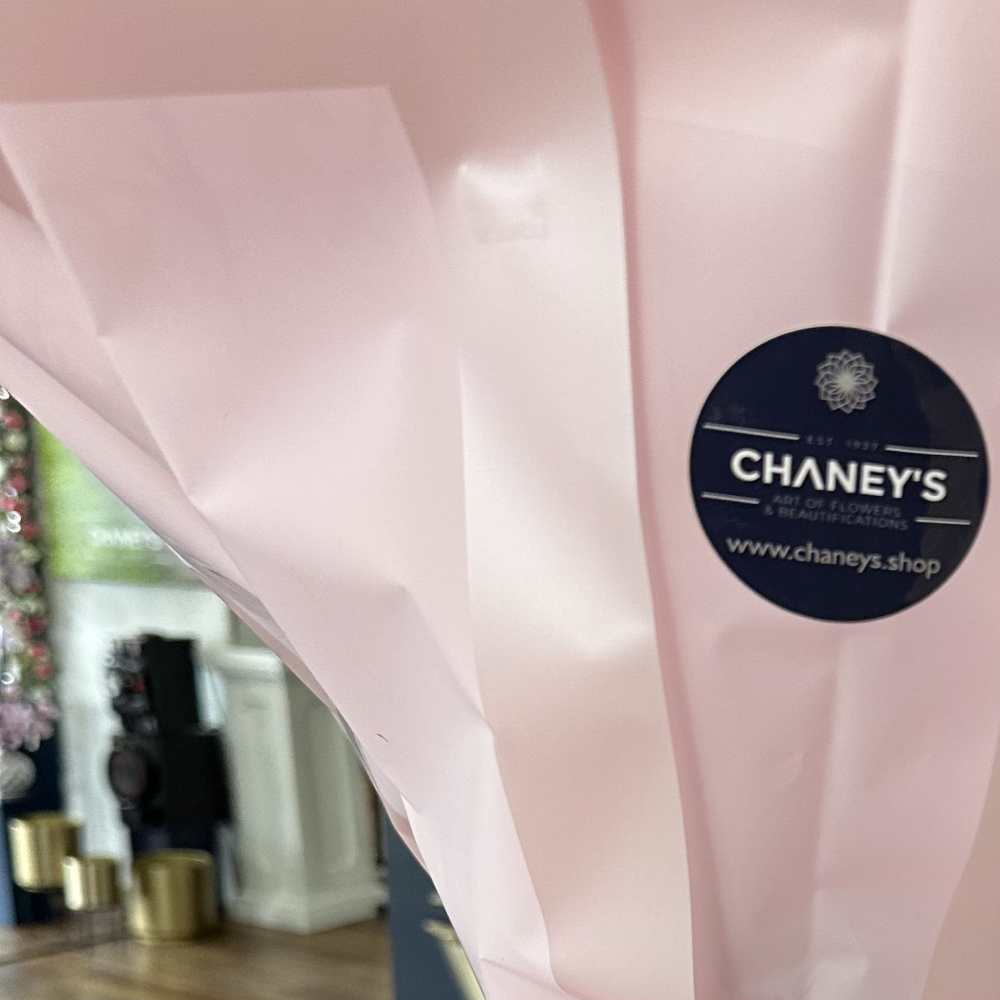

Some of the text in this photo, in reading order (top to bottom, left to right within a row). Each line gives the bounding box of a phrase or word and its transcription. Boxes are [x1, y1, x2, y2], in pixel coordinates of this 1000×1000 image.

[730, 447, 948, 502] CHANEY'S
[772, 494, 903, 518] ART OF FLOWERS
[778, 505, 909, 531] BEAUTIFICATIONS
[726, 535, 941, 579] www.chaneys.shop
